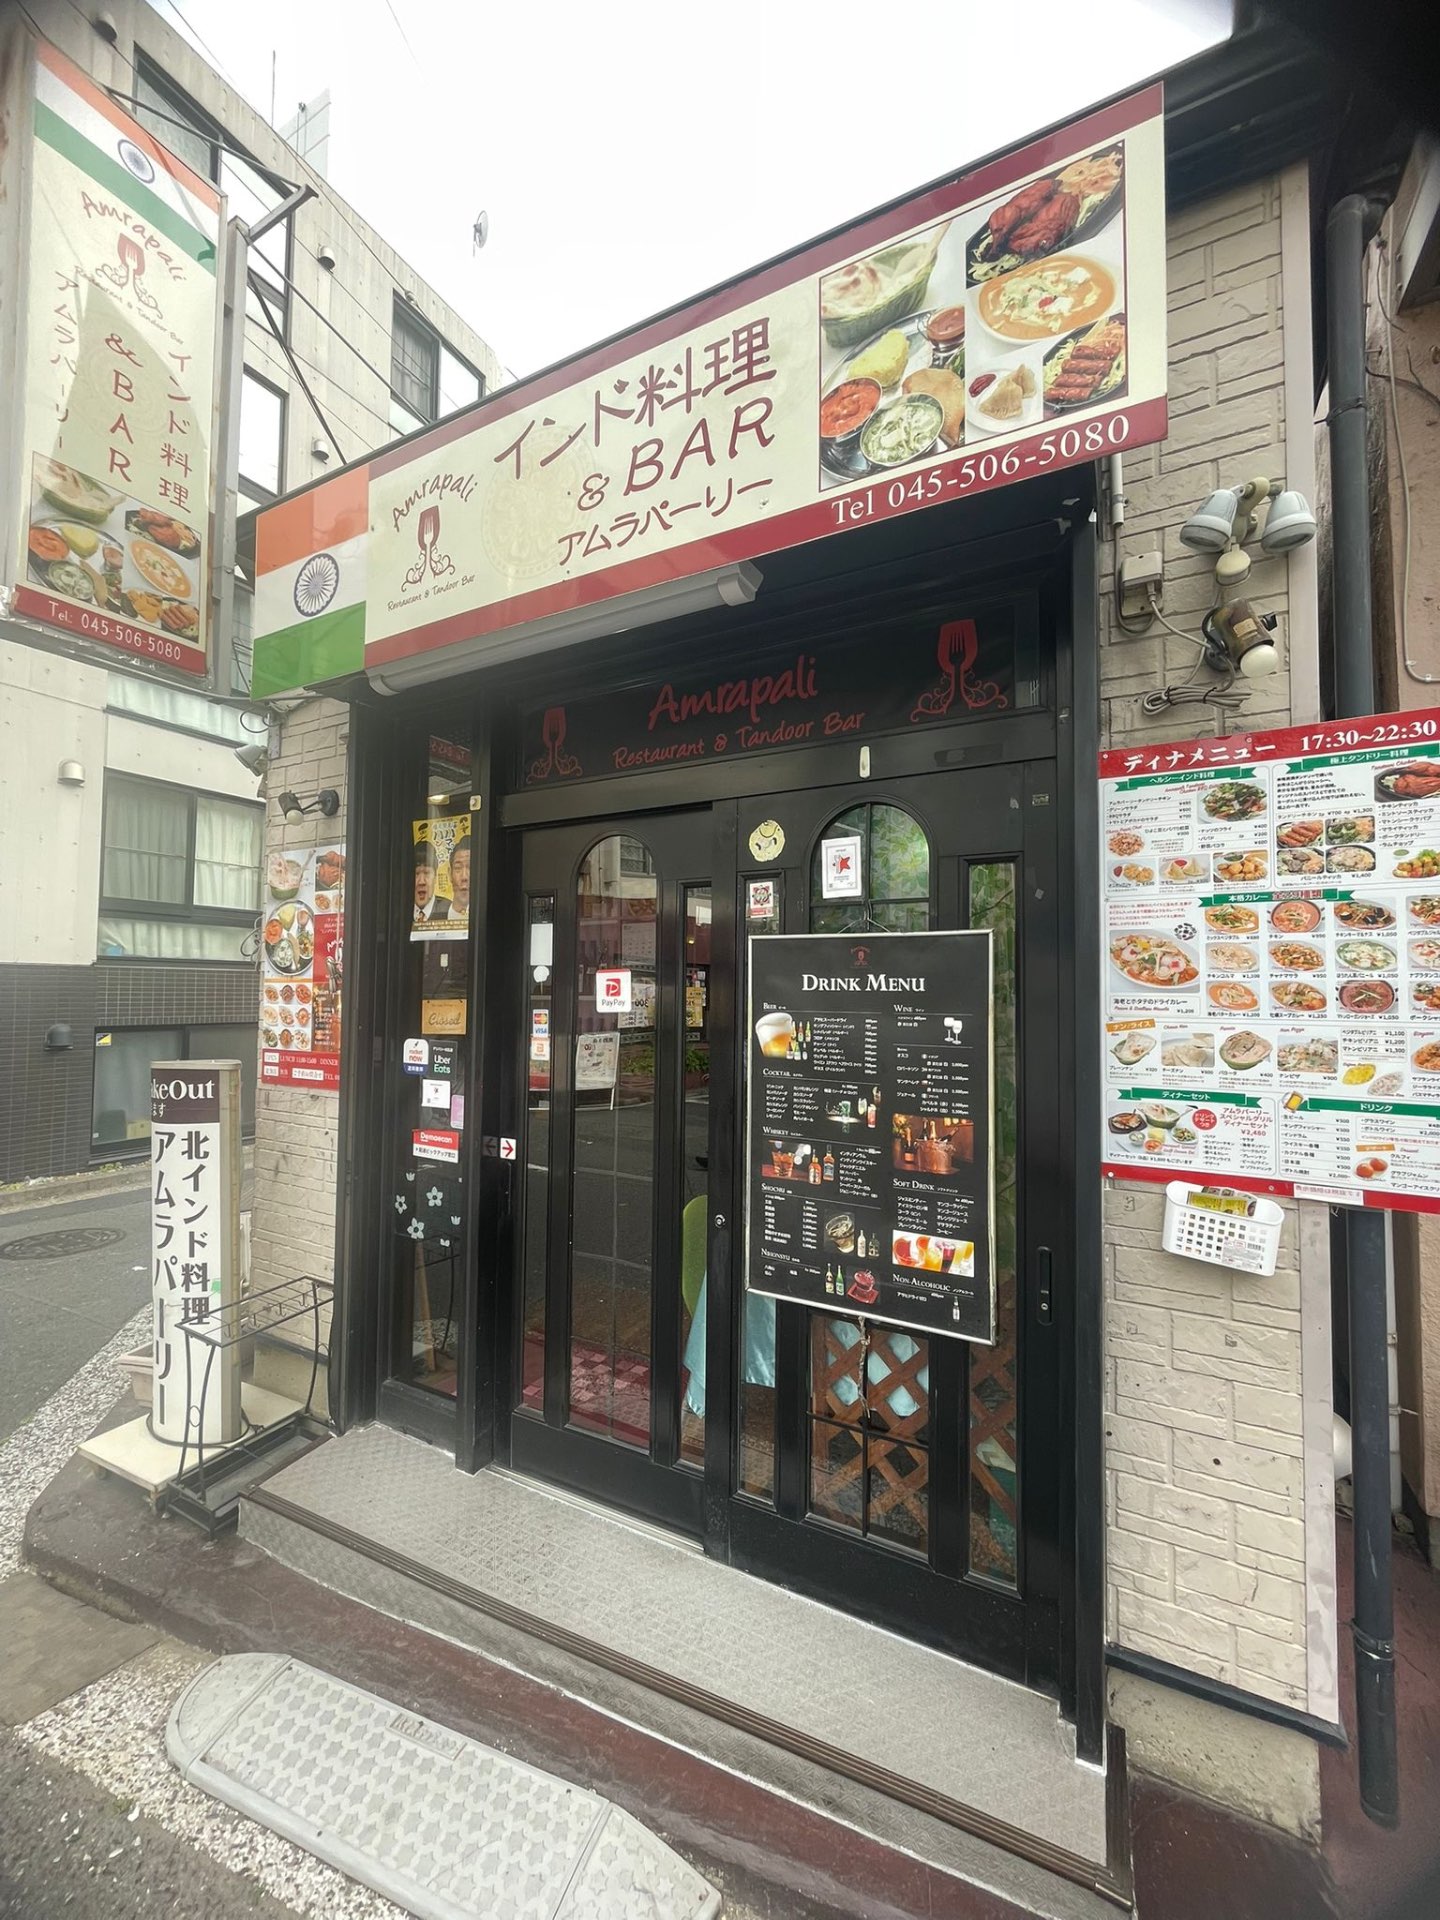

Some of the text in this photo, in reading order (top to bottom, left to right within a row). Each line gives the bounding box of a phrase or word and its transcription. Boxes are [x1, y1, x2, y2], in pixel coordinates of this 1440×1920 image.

[81, 190, 187, 282] Amrapali
[50, 270, 77, 450] アムラパーリー
[104, 332, 144, 484] & BAR
[494, 316, 777, 480] インド料理
[158, 350, 194, 515] インド料理
[577, 397, 775, 512] & BAR
[391, 472, 479, 532] Amrapali
[831, 415, 1130, 525] Tel 045-506-5080
[557, 478, 774, 566] アムラパーリー
[432, 581, 460, 599] Tandoor
[460, 574, 476, 589] Bar
[81, 612, 182, 661] 045-506-5080
[647, 655, 818, 731] Amrapali
[612, 737, 706, 769] Restaurant
[736, 719, 815, 748] Tandoor
[824, 709, 866, 735] Bar
[1150, 772, 1215, 783] ヘルシーインド料理
[1229, 894, 1268, 902] 本格カレー
[601, 998, 625, 1006] PayPay
[434, 1054, 451, 1064] Uber
[434, 1064, 451, 1074] Eats
[1162, 1092, 1210, 1100] ディナーセット
[1360, 1103, 1392, 1112] ドリンク
[181, 1130, 211, 1327] 北インド料理
[153, 1130, 178, 1426] アムラパーリー
